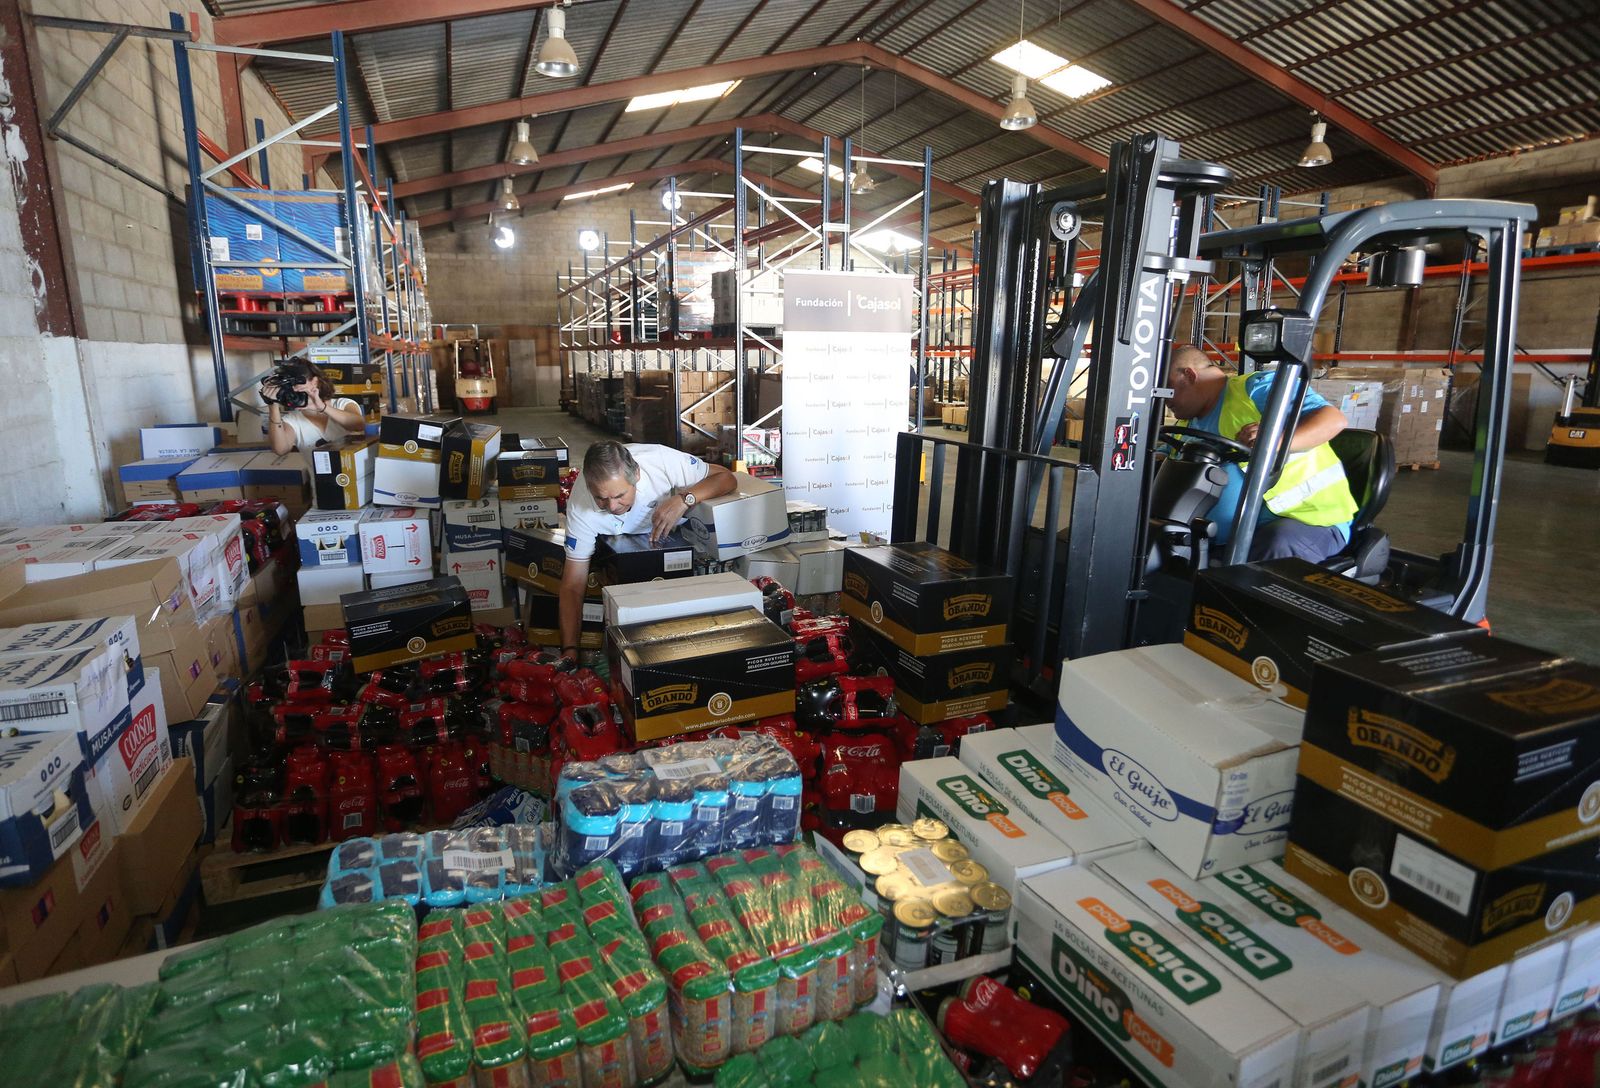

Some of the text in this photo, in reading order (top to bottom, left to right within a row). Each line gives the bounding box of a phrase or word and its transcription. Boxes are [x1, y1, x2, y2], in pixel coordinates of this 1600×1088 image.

[795, 296, 901, 312] Fundación Cajasol
[1127, 276, 1160, 409] TOYOTA
[948, 602, 986, 616] OBANDO
[1314, 574, 1397, 611] OBANDO
[1200, 617, 1241, 645] OBANDO
[647, 690, 693, 709] OBANDO
[91, 728, 113, 757] MUSA
[123, 712, 155, 758] COOSOL
[1355, 725, 1442, 775] OBANDO
[130, 745, 159, 784] Tradicional
[1005, 755, 1050, 792] Dino
[1109, 755, 1126, 776] El
[1127, 770, 1169, 810] Guijo
[1343, 773, 1373, 793] PICOS
[945, 780, 989, 814] Dino
[924, 792, 943, 815] BOLSAS
[950, 816, 979, 848] ACEITUNAS
[1229, 869, 1296, 917] Dino
[1129, 930, 1208, 992] Dino
[1200, 911, 1281, 970] Dino
[1059, 951, 1120, 1022] Dino
[1064, 929, 1096, 960] BOLSAS
[1097, 953, 1110, 970] DE
[1111, 968, 1165, 1017] ACEITUNAS
